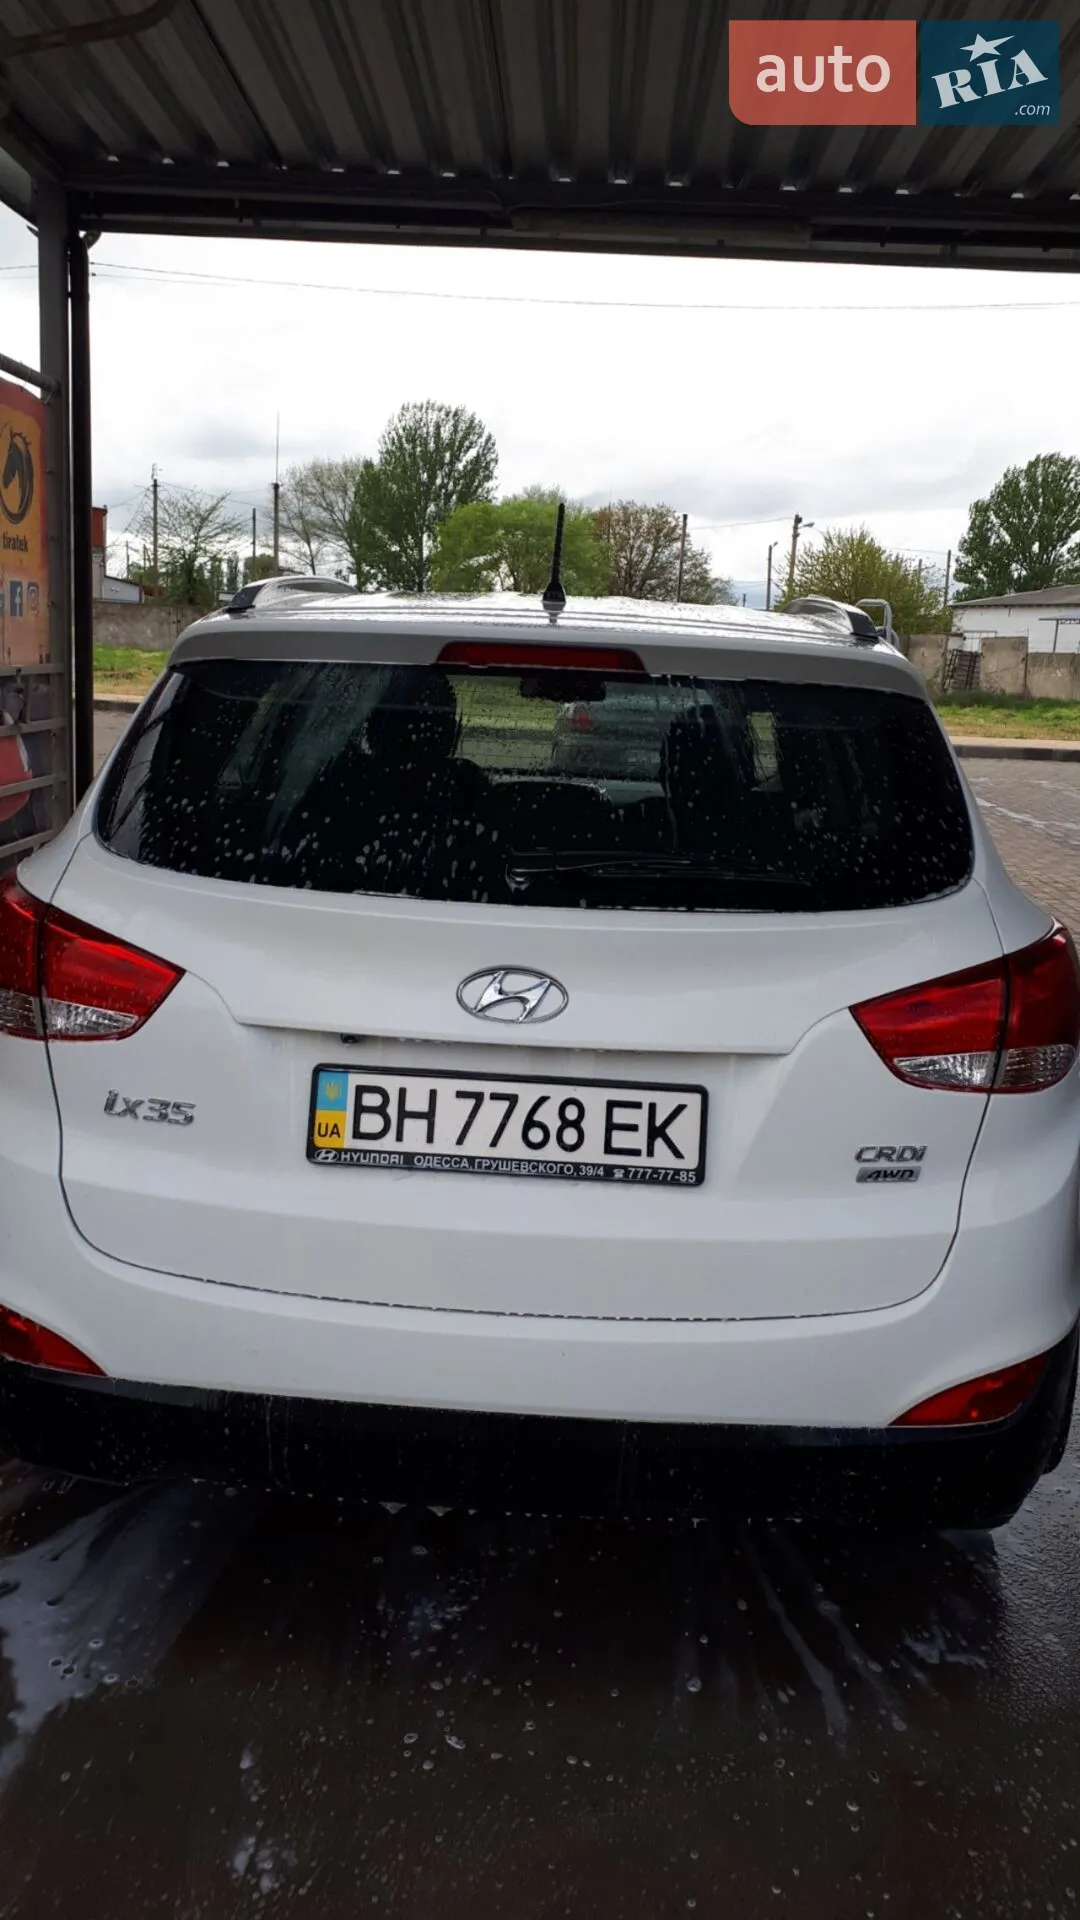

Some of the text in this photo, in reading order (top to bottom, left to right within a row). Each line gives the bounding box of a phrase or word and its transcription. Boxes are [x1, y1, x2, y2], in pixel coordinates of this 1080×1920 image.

[103, 1089, 196, 1126] ix35
[352, 1084, 688, 1160] BH 7768 EK
[317, 1122, 341, 1138] UA
[340, 1150, 404, 1165] HYUNDAI
[627, 1167, 697, 1183] 777-77-85
